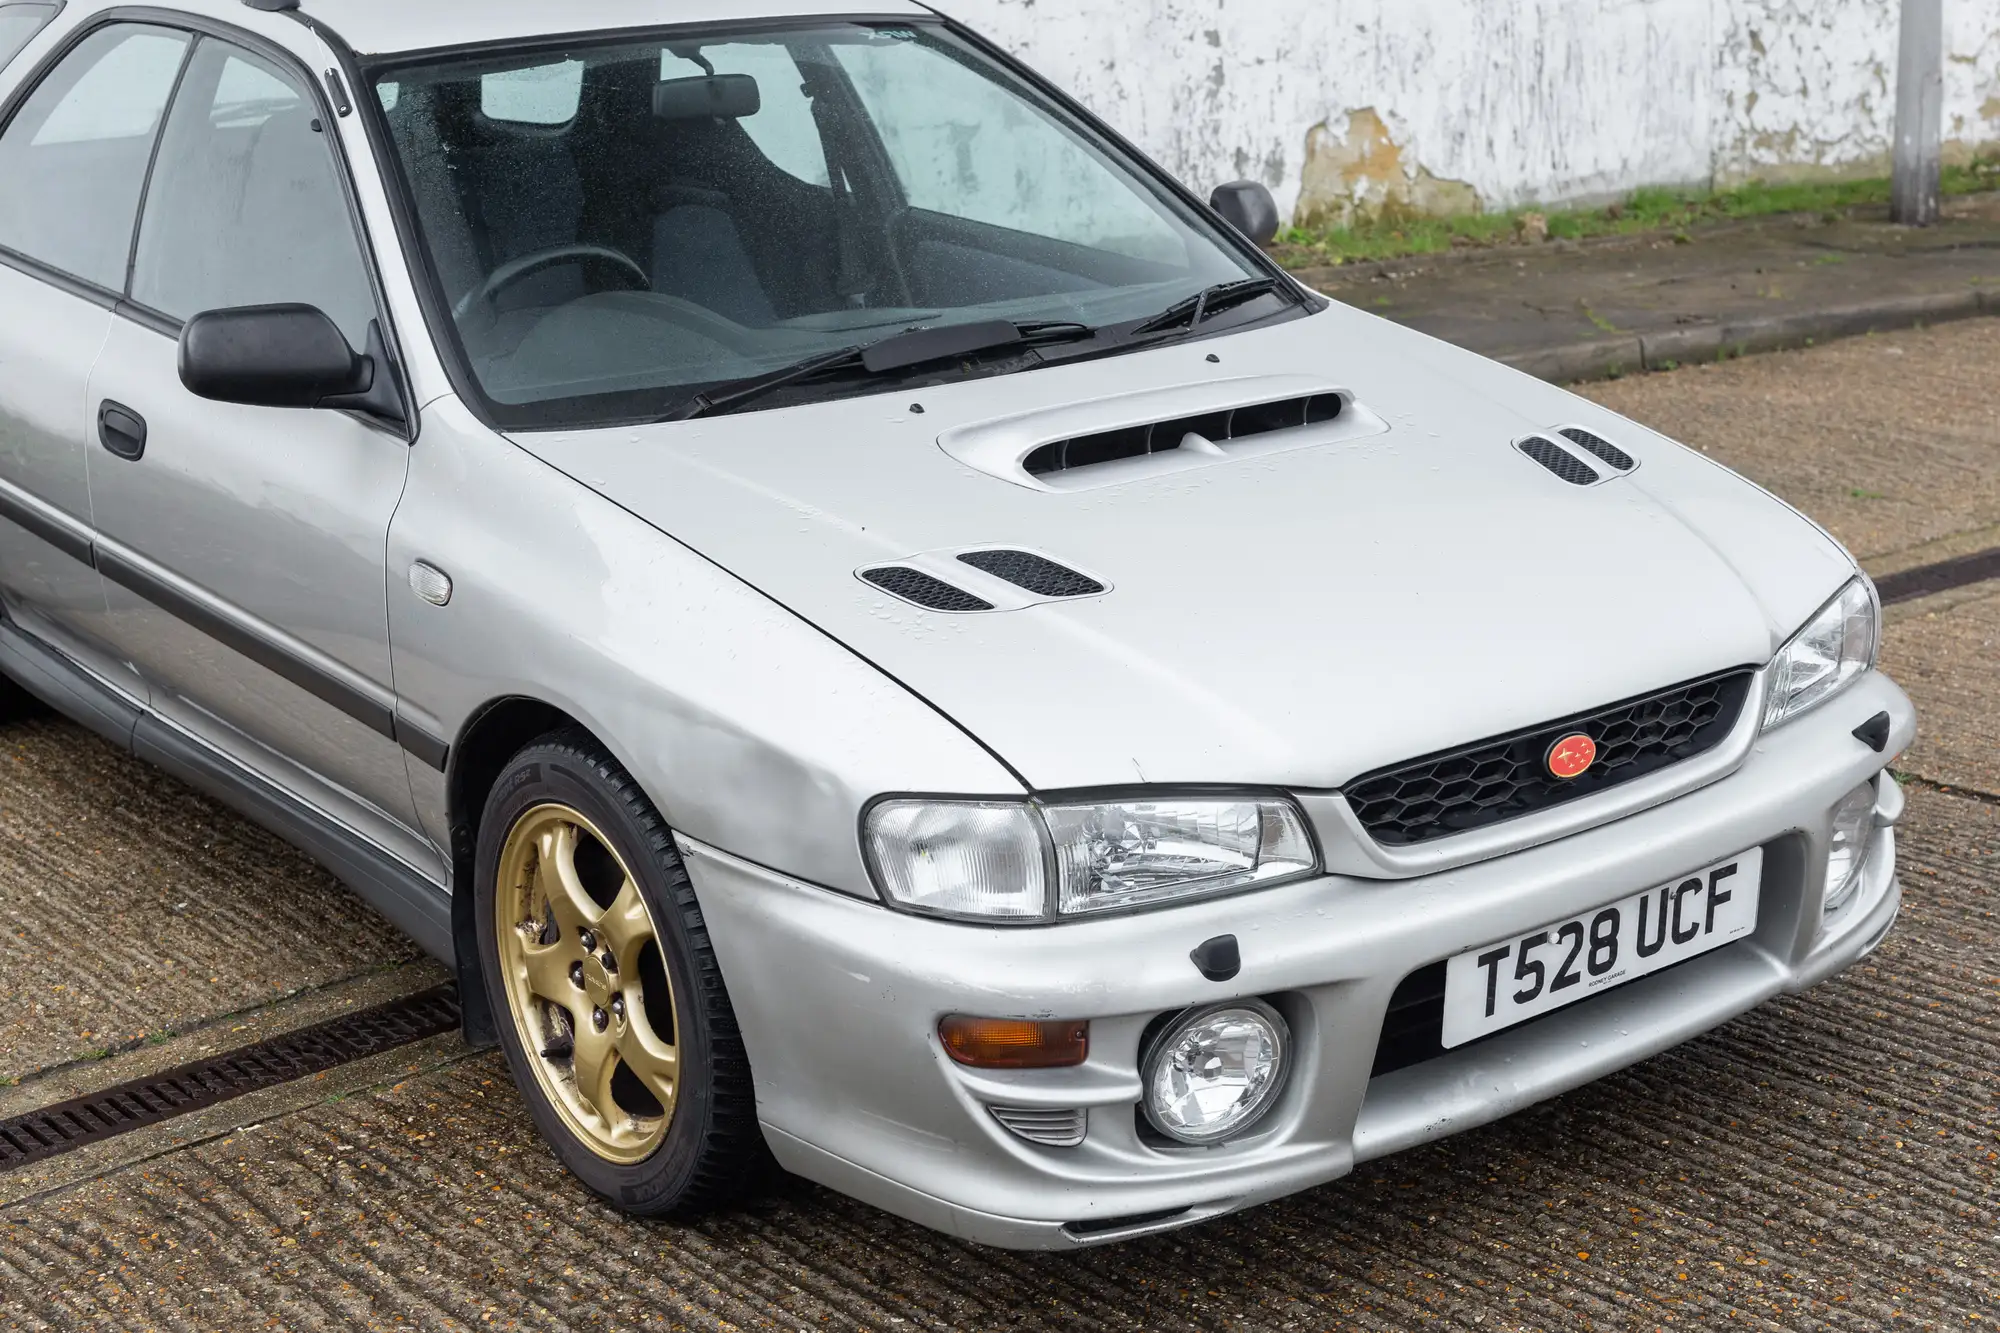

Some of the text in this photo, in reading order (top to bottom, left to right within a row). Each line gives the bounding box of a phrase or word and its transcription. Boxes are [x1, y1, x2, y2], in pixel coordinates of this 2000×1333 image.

[1478, 862, 1738, 1018] T528 UCF
[1588, 976, 1607, 988] RODNEY
[1607, 969, 1627, 981] GARAGE
